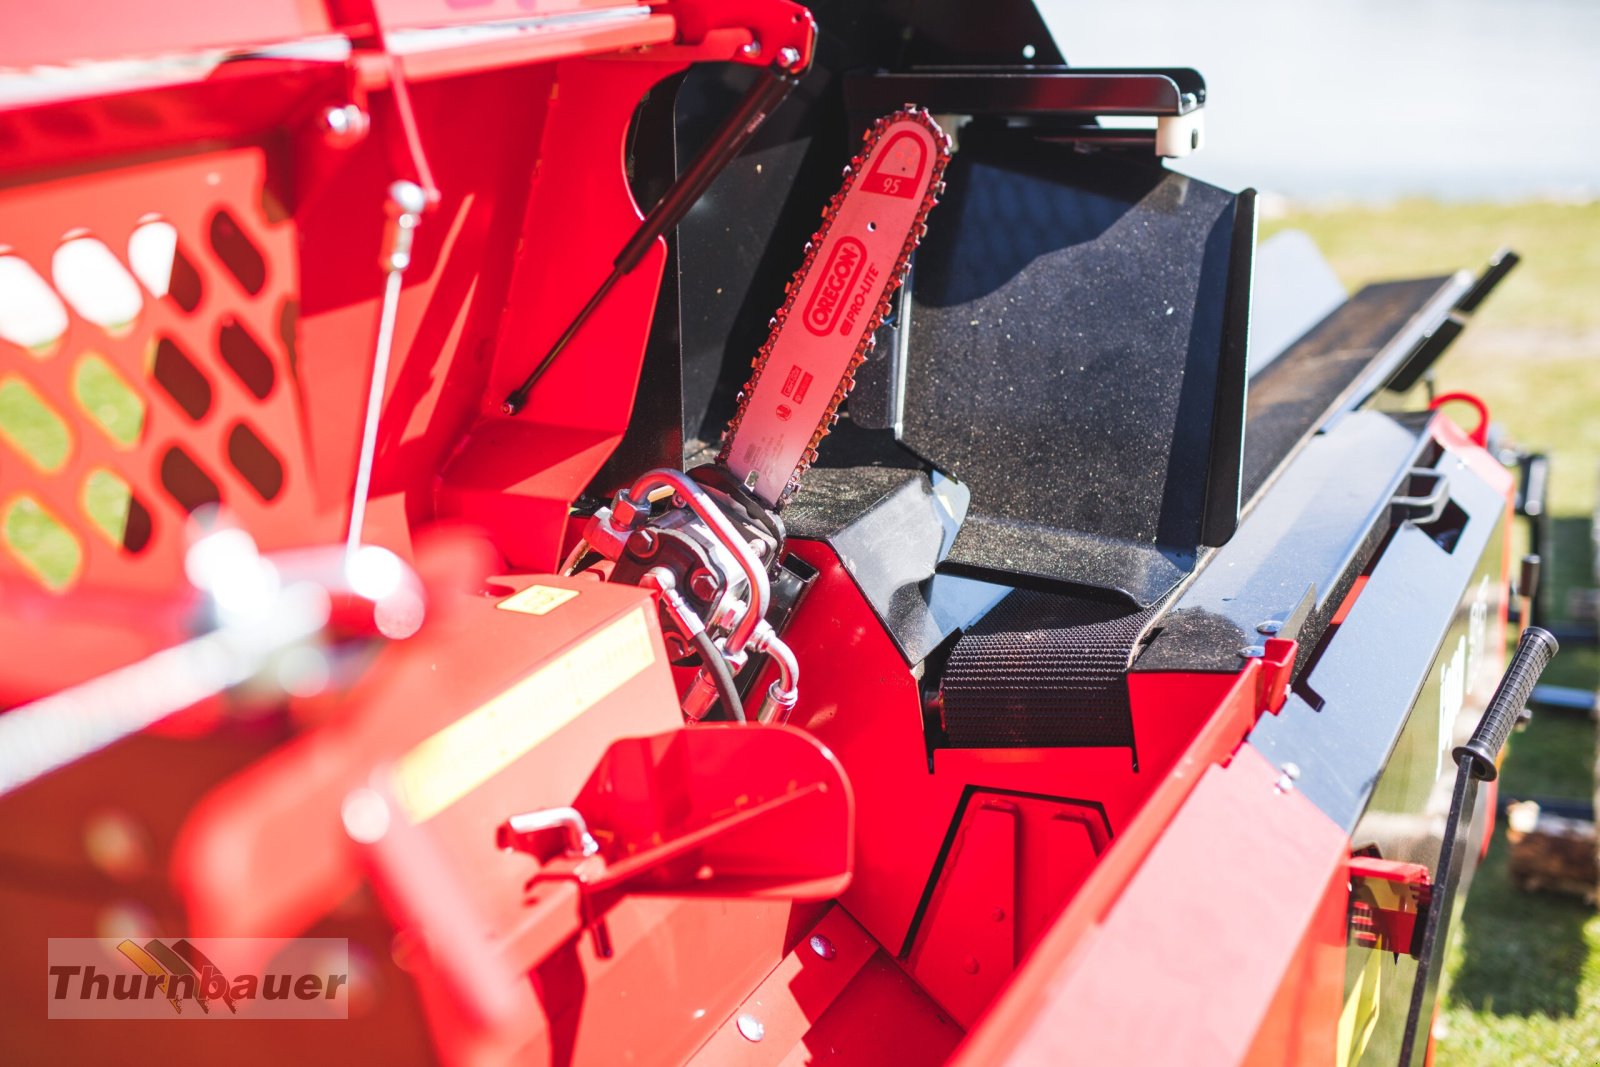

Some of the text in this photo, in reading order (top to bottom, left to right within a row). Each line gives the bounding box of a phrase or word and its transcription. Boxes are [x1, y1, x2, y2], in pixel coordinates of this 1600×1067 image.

[883, 177, 902, 194] 95
[812, 247, 858, 326] OREGON
[846, 262, 879, 323] PRO-LITE
